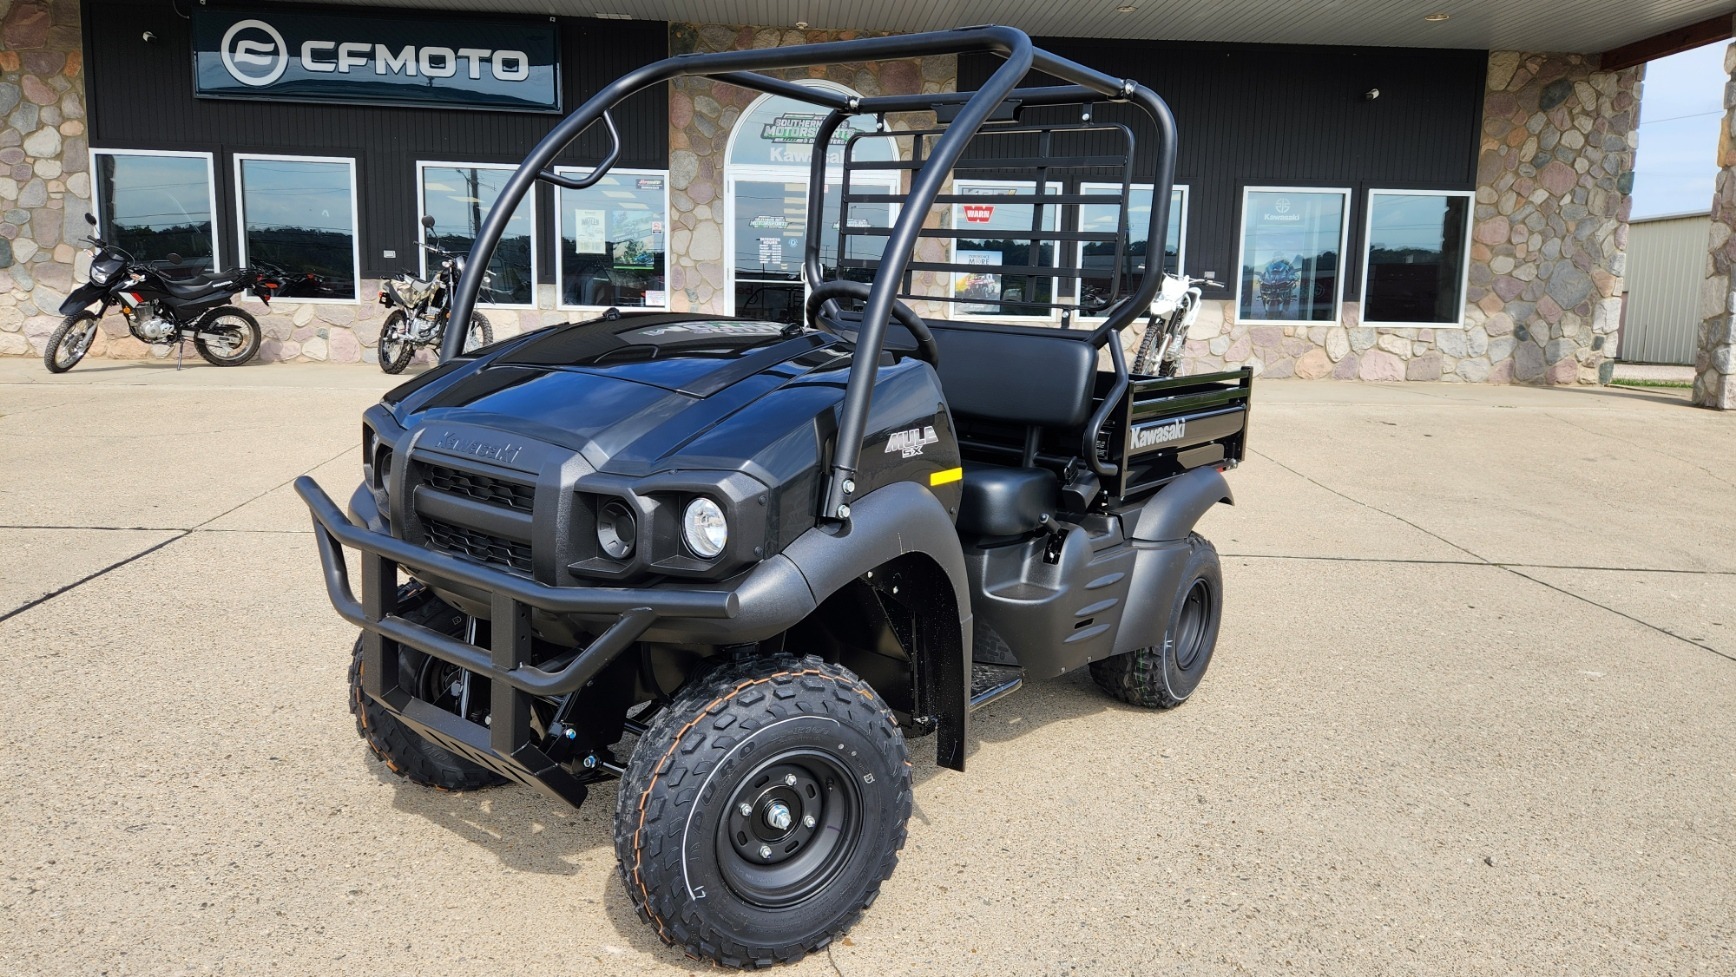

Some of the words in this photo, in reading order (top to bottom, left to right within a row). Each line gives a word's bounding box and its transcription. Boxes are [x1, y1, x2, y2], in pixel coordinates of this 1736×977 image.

[301, 40, 529, 81] CFMOTO
[764, 126, 856, 139] MOTORSRTS
[966, 209, 990, 219] WARN
[1264, 213, 1300, 221] Kawasaki
[435, 431, 522, 464] Kawasaki
[885, 425, 939, 453] MULE
[1130, 418, 1186, 449] Kawasaki
